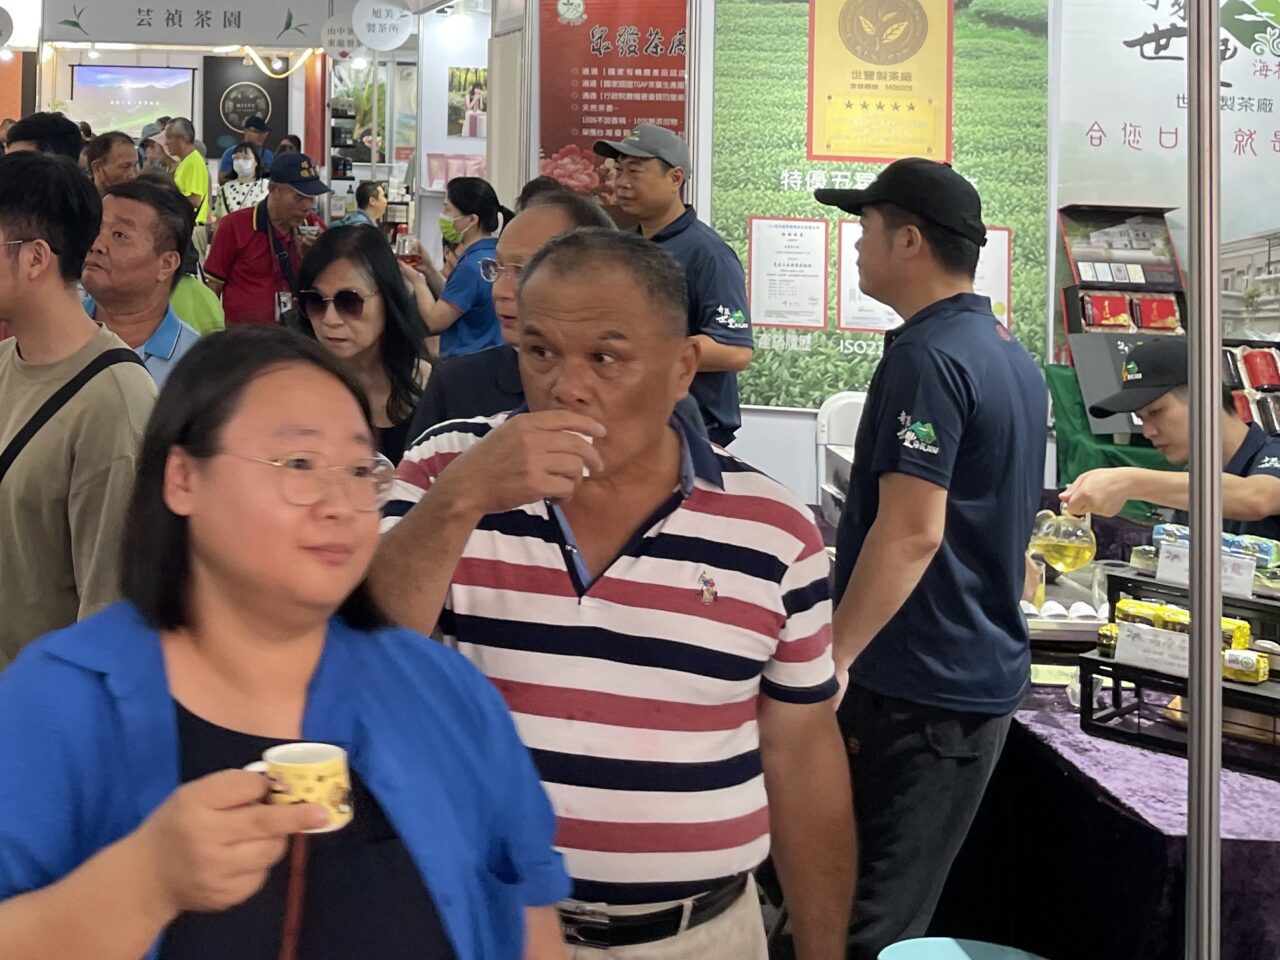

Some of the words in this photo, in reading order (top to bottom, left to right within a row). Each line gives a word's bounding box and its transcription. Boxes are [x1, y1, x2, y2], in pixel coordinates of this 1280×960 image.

[136, 7, 242, 29] 芸禎茶園
[367, 22, 400, 34] 製茶所
[850, 70, 913, 82] 世豐製茶廠
[1176, 94, 1274, 114] 世製茶廠
